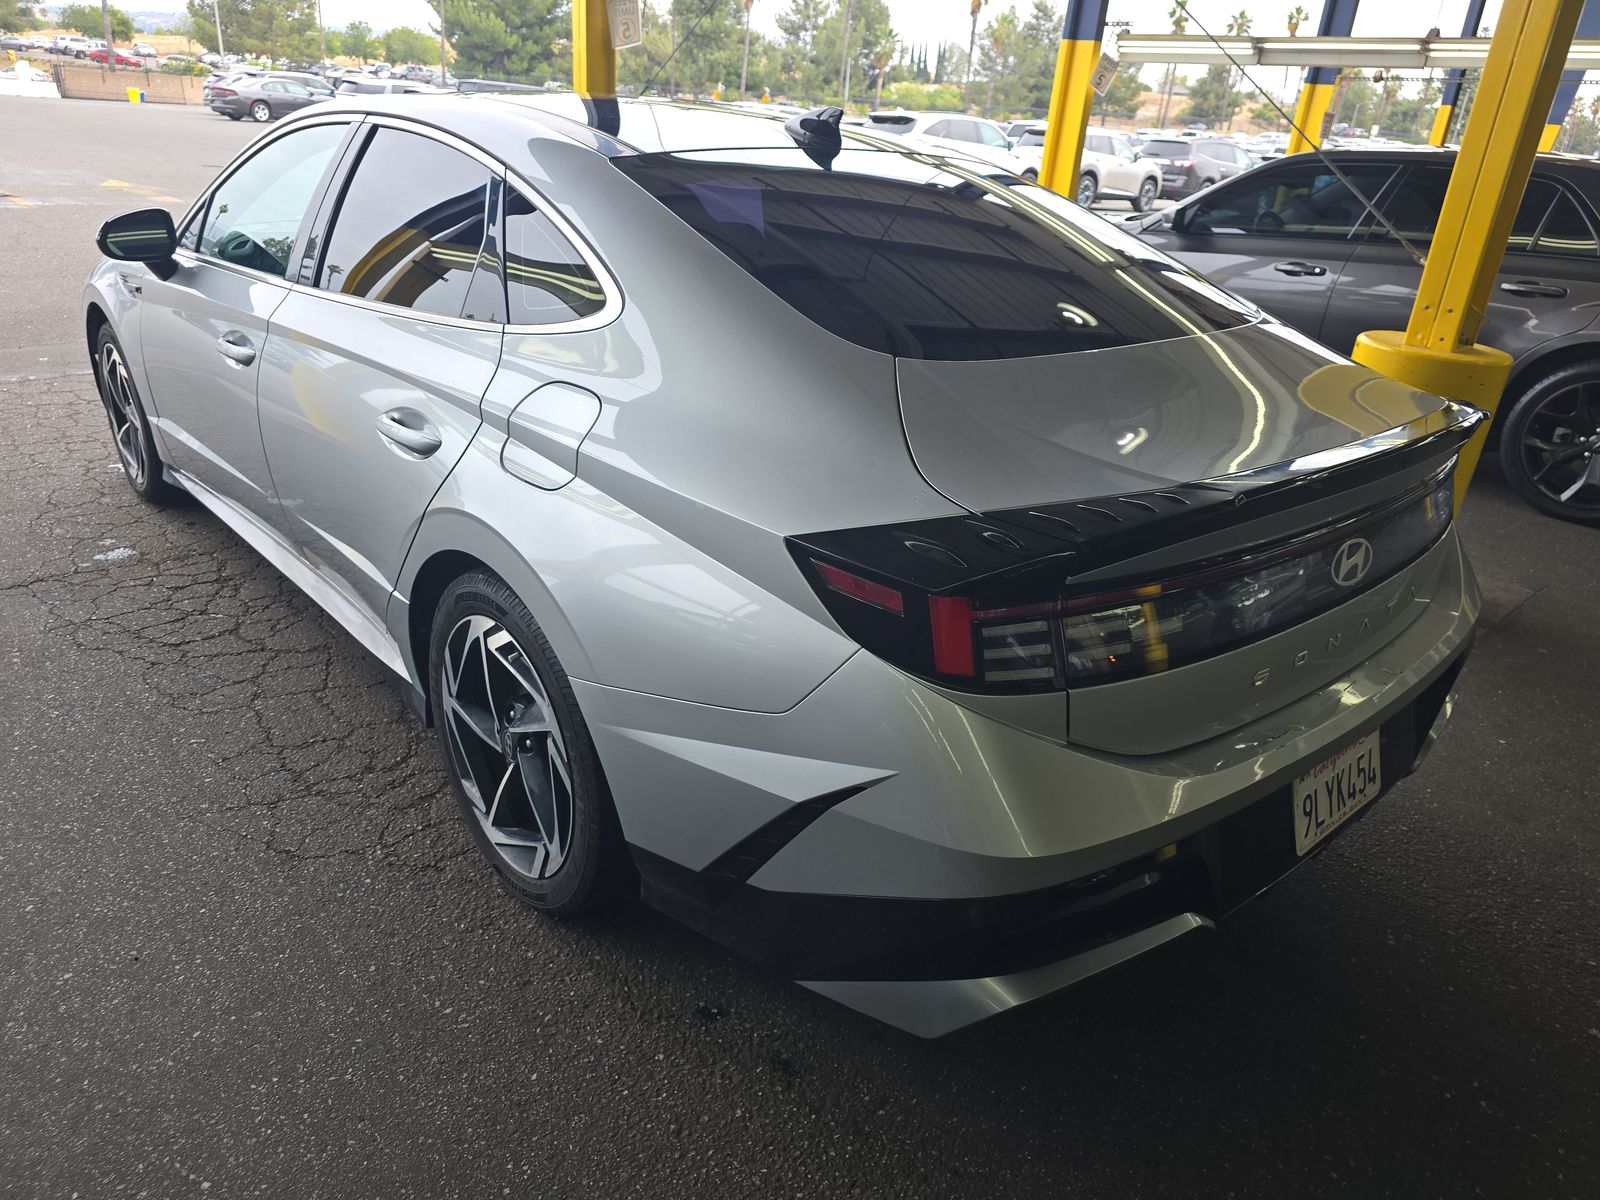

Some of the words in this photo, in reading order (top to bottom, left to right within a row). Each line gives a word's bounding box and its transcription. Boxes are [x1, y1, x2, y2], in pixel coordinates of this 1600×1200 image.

[1096, 74, 1105, 86] 5
[1253, 586, 1417, 687] SONATA
[1302, 747, 1377, 840] 9LYK454
